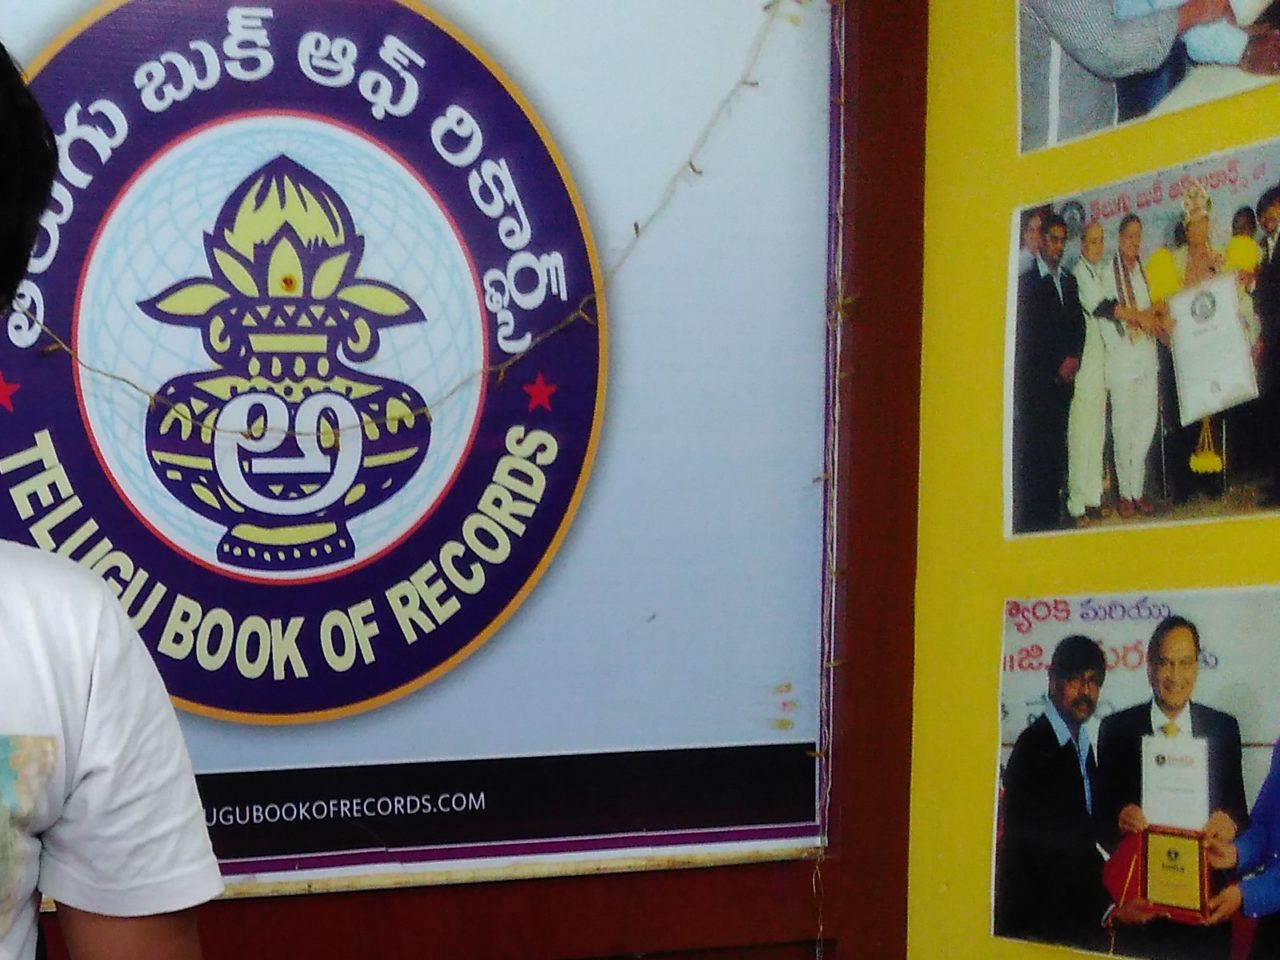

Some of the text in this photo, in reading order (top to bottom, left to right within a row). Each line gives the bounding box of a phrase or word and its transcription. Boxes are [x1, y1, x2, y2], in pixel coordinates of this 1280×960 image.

[157, 593, 309, 681] BOOK
[320, 599, 380, 672] OF
[386, 425, 559, 645] RECORDS
